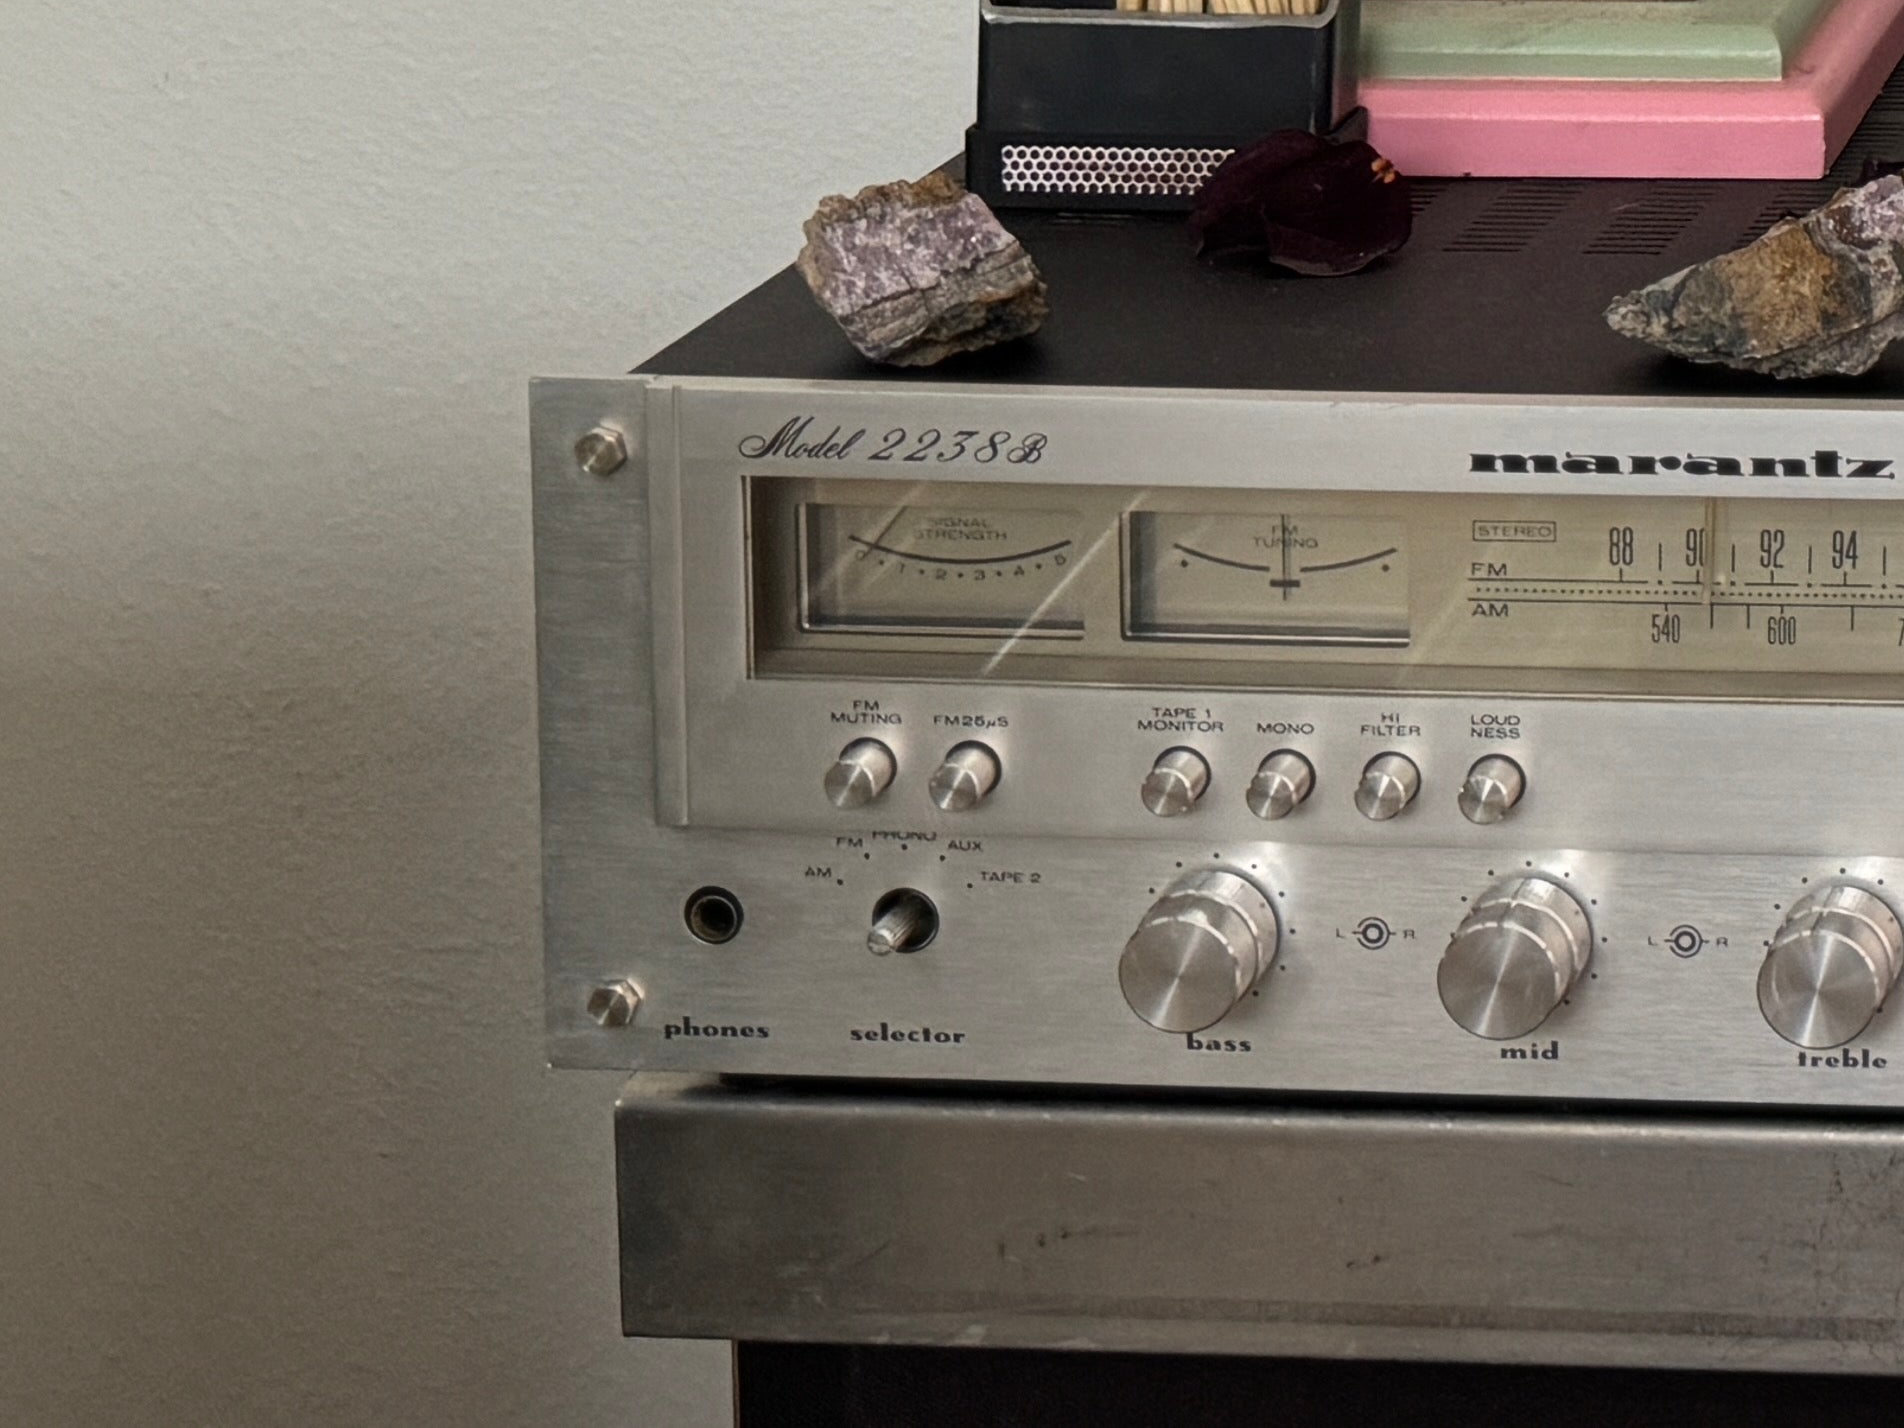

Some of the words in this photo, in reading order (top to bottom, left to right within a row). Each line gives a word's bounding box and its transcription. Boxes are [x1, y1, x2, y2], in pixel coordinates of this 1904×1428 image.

[739, 416, 866, 461] Model
[867, 428, 1048, 464] 2238B
[1469, 450, 1896, 480] marantz
[912, 528, 1008, 542] STRENGTH
[1477, 524, 1554, 539] STEREO
[1608, 526, 1635, 567] 88
[1760, 529, 1785, 570] 92
[1832, 530, 1858, 571] 94
[1470, 562, 1508, 578] FM
[1471, 603, 1510, 619] AM
[1651, 614, 1681, 644] 540
[1767, 616, 1797, 646] 600
[853, 700, 880, 712] FM
[830, 711, 903, 725] MUTING
[1152, 707, 1197, 720] TAPE
[1470, 713, 1521, 726] LOUD
[1137, 720, 1225, 734] MONITOR
[1256, 722, 1315, 735] MONO
[1360, 724, 1422, 737] FILTER
[1470, 726, 1521, 739] NESS
[836, 836, 863, 849] FM
[948, 840, 983, 852] AUX
[804, 866, 832, 879] AM
[980, 871, 1025, 884] TAPE
[1029, 872, 1041, 884] 2
[663, 1015, 770, 1040] phones
[849, 1021, 966, 1044] selector
[1186, 1031, 1252, 1053] bass
[1500, 1040, 1560, 1061] mid
[1798, 1047, 1888, 1070] treble
